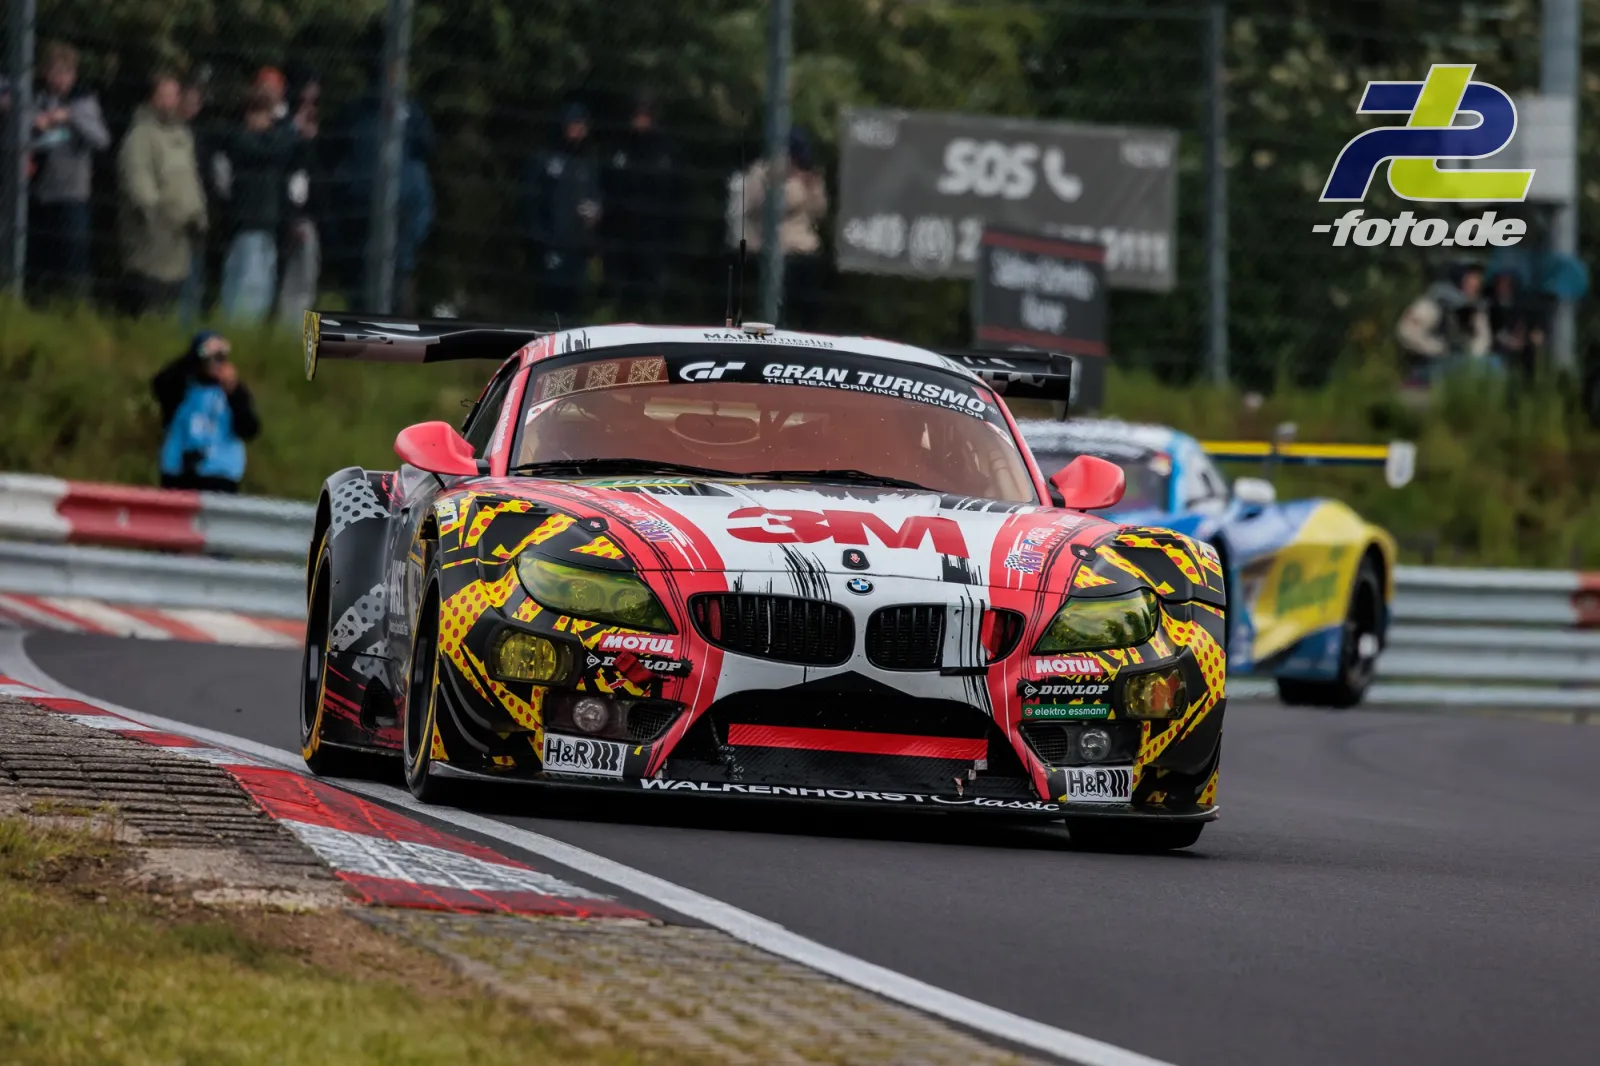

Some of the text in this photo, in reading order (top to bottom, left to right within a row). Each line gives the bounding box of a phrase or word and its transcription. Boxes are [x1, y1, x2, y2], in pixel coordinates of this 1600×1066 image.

[937, 138, 1039, 199] SOS
[679, 361, 746, 382] GT
[762, 363, 986, 413] GRAN TURISMO
[799, 379, 836, 388] REAL
[839, 383, 900, 397] DRIVING
[903, 392, 985, 420] SIMULATOR
[726, 506, 970, 559] 3M
[602, 635, 674, 654] MOTUL
[601, 656, 682, 671] DLOP
[1035, 659, 1100, 674] MOTUL
[1038, 685, 1110, 695] DUNLOP
[1034, 707, 1067, 716] elektro
[1068, 707, 1107, 716] essmann
[545, 737, 592, 769] H&R
[639, 778, 1060, 811] WALKENHORST Classic
[1067, 769, 1112, 797] H&R
